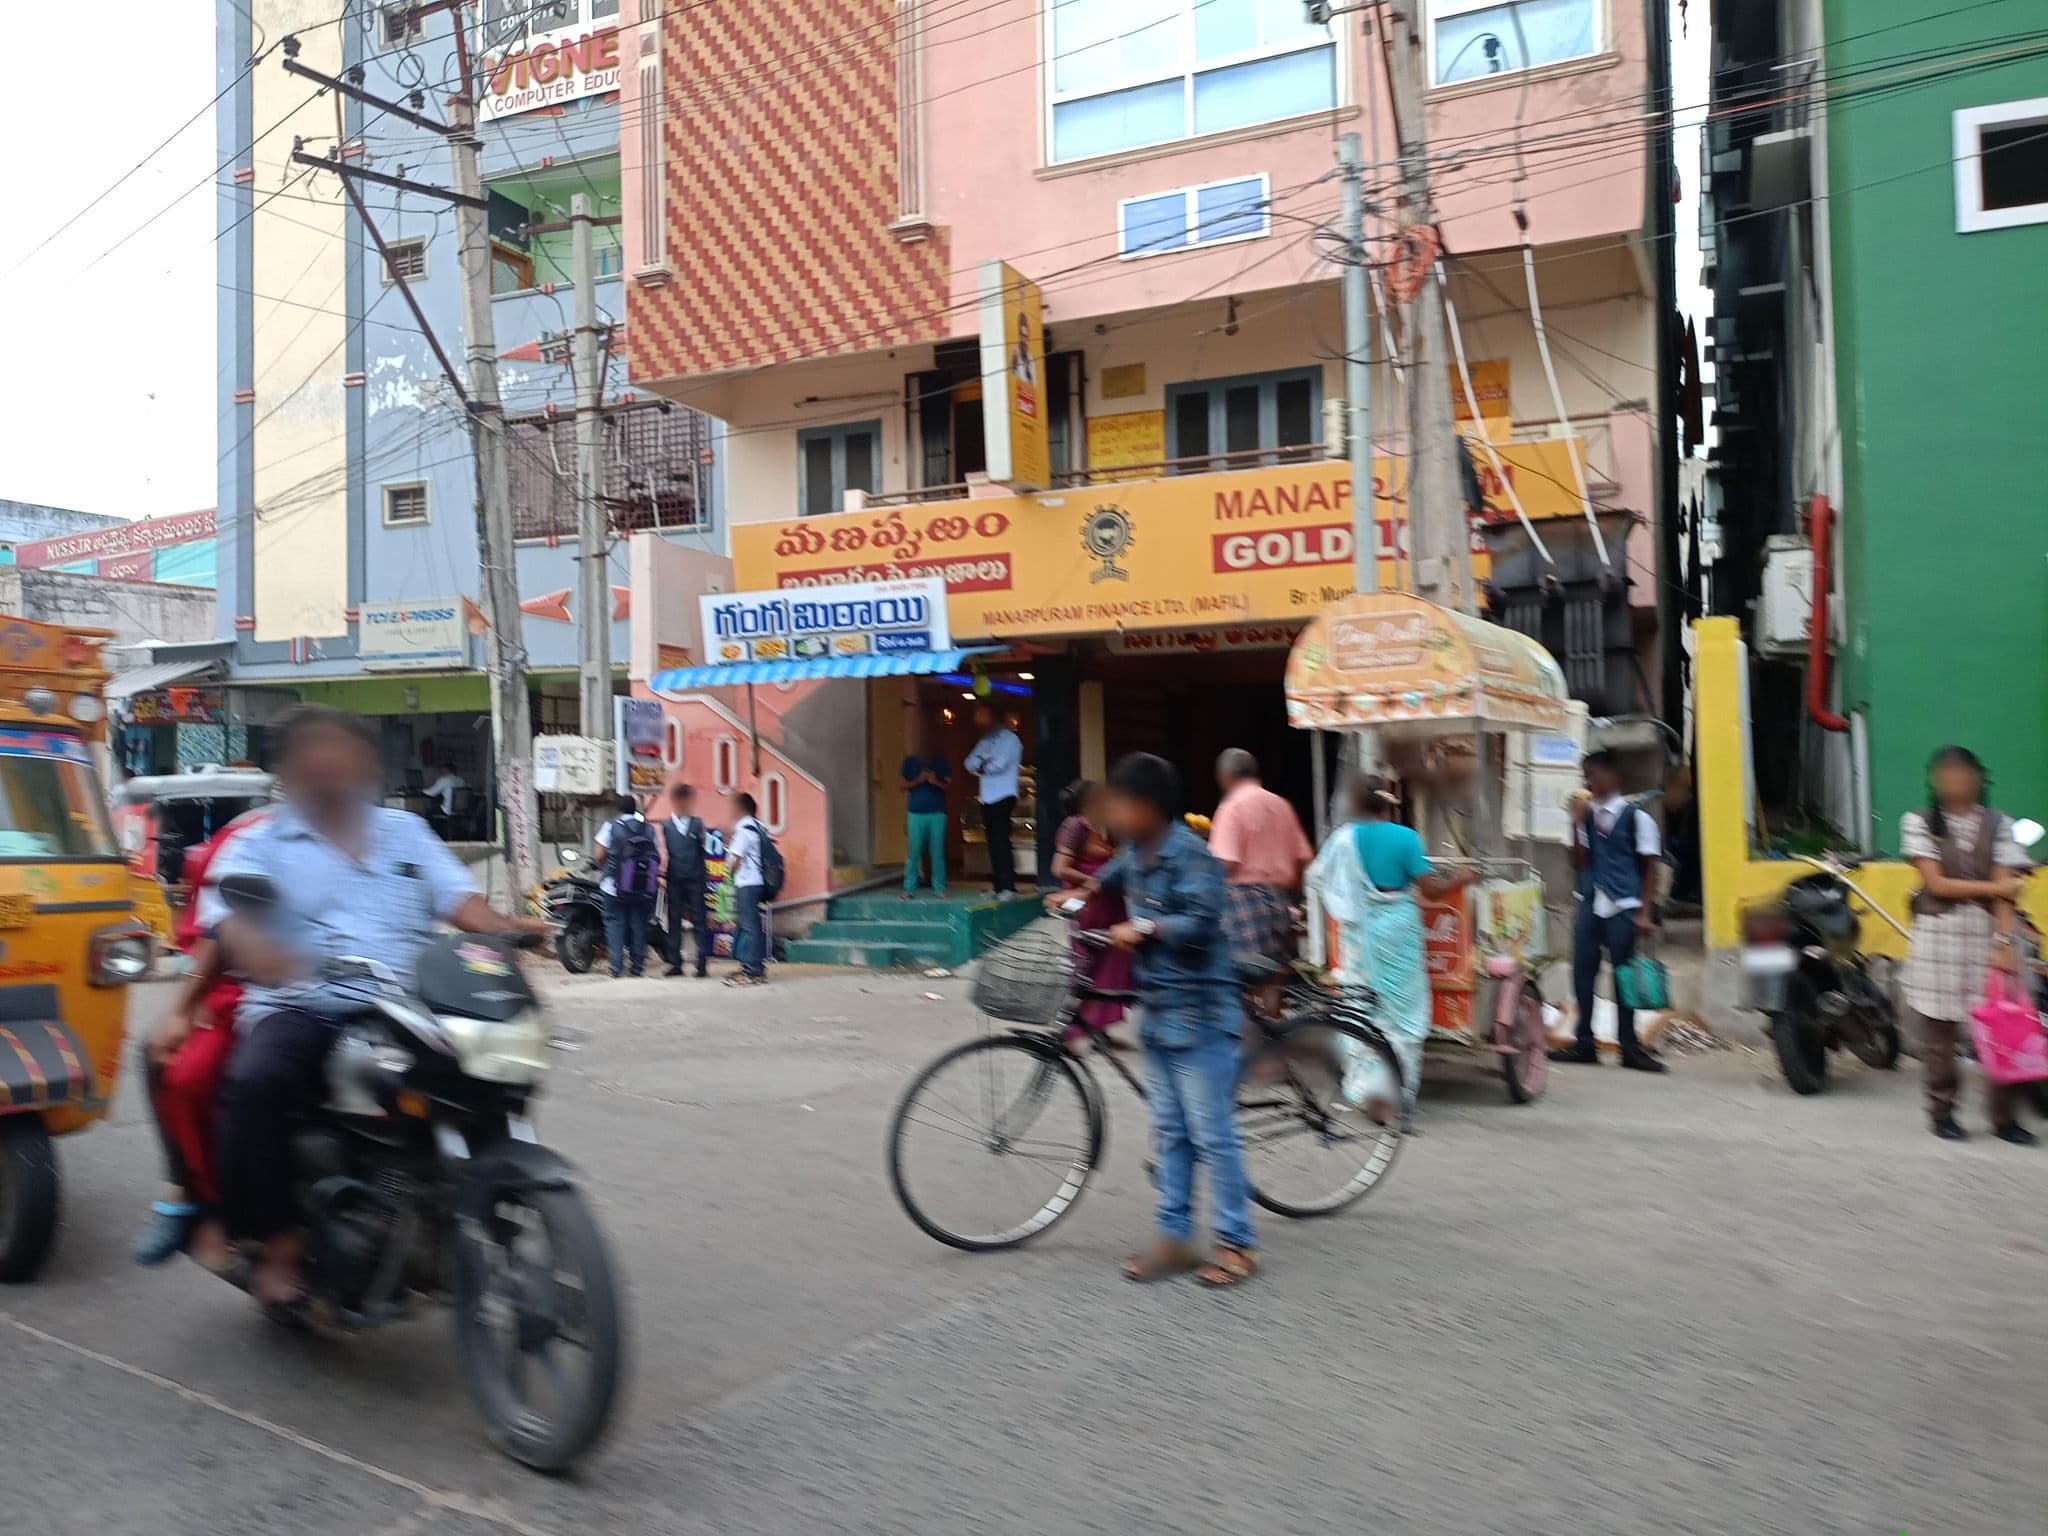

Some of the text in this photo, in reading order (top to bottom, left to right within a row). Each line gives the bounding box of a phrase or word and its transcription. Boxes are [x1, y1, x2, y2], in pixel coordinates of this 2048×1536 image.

[495, 80, 575, 113] COMPUTER
[1222, 528, 1354, 569] GOLD
[1087, 600, 1153, 620] FINANCE
